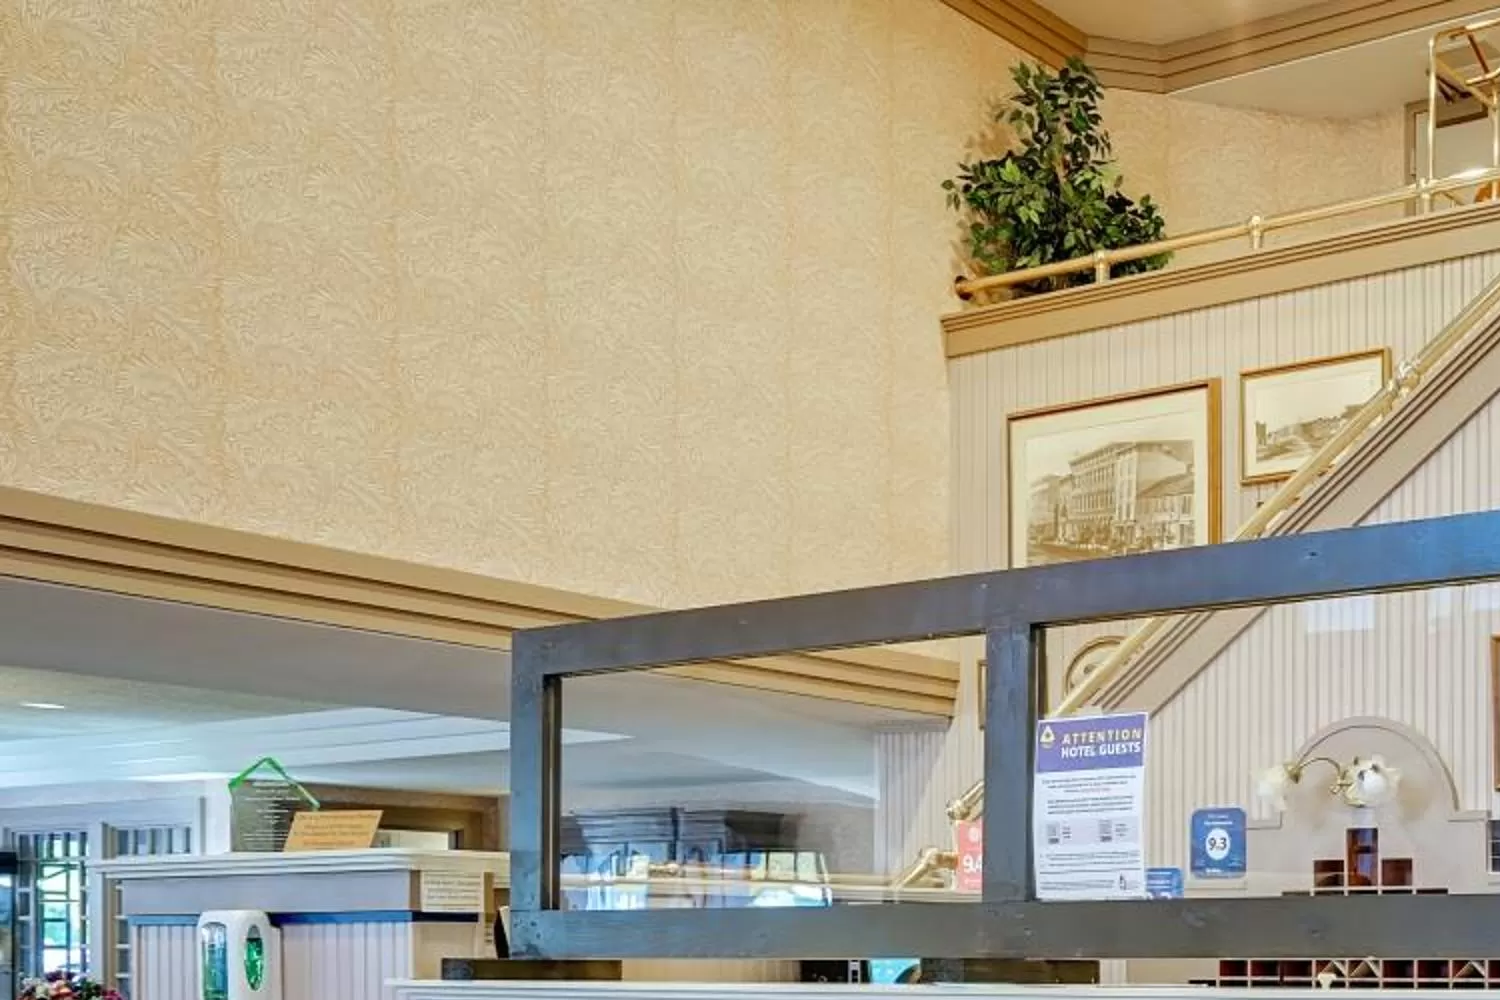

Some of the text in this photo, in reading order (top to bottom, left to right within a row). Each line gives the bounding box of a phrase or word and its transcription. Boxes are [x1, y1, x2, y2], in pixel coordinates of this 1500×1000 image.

[1061, 728, 1142, 745] ATTENTION
[1060, 742, 1141, 759] HOTEL GUESTS
